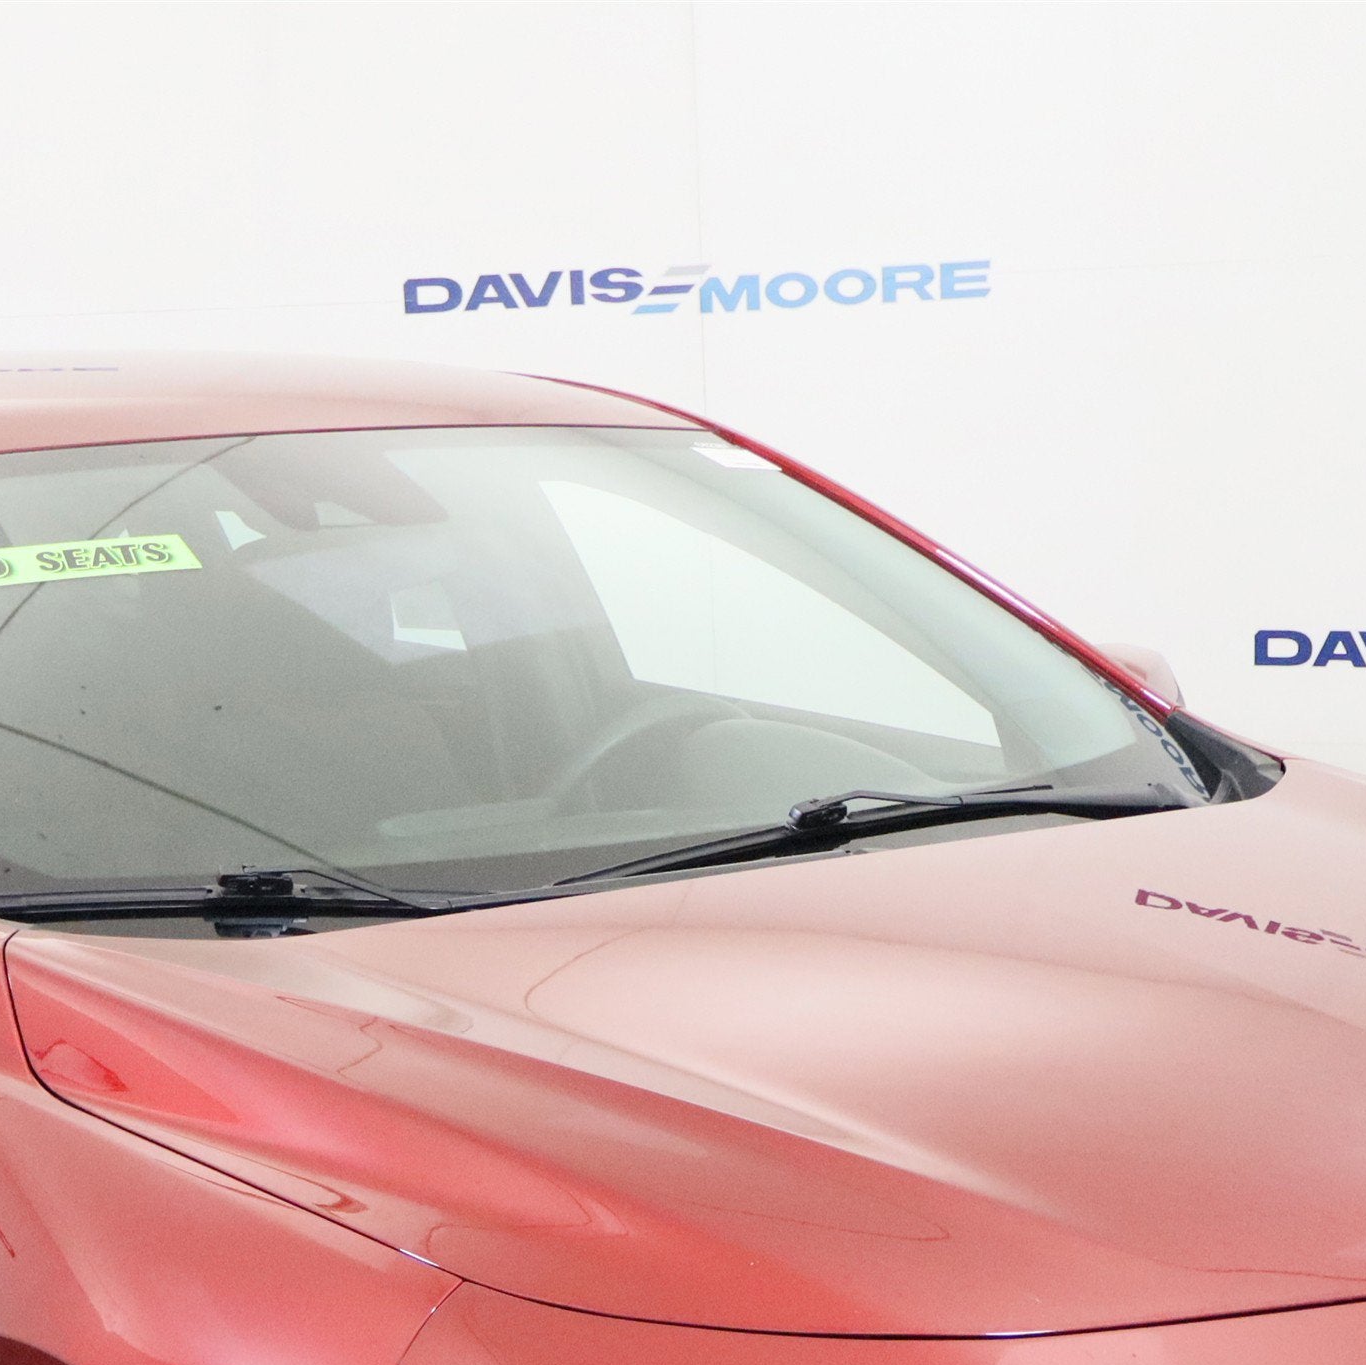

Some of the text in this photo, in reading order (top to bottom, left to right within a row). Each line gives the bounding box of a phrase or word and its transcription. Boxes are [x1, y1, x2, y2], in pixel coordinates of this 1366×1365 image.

[403, 260, 991, 314] DAVIS MOORE
[34, 541, 172, 573] SEATS
